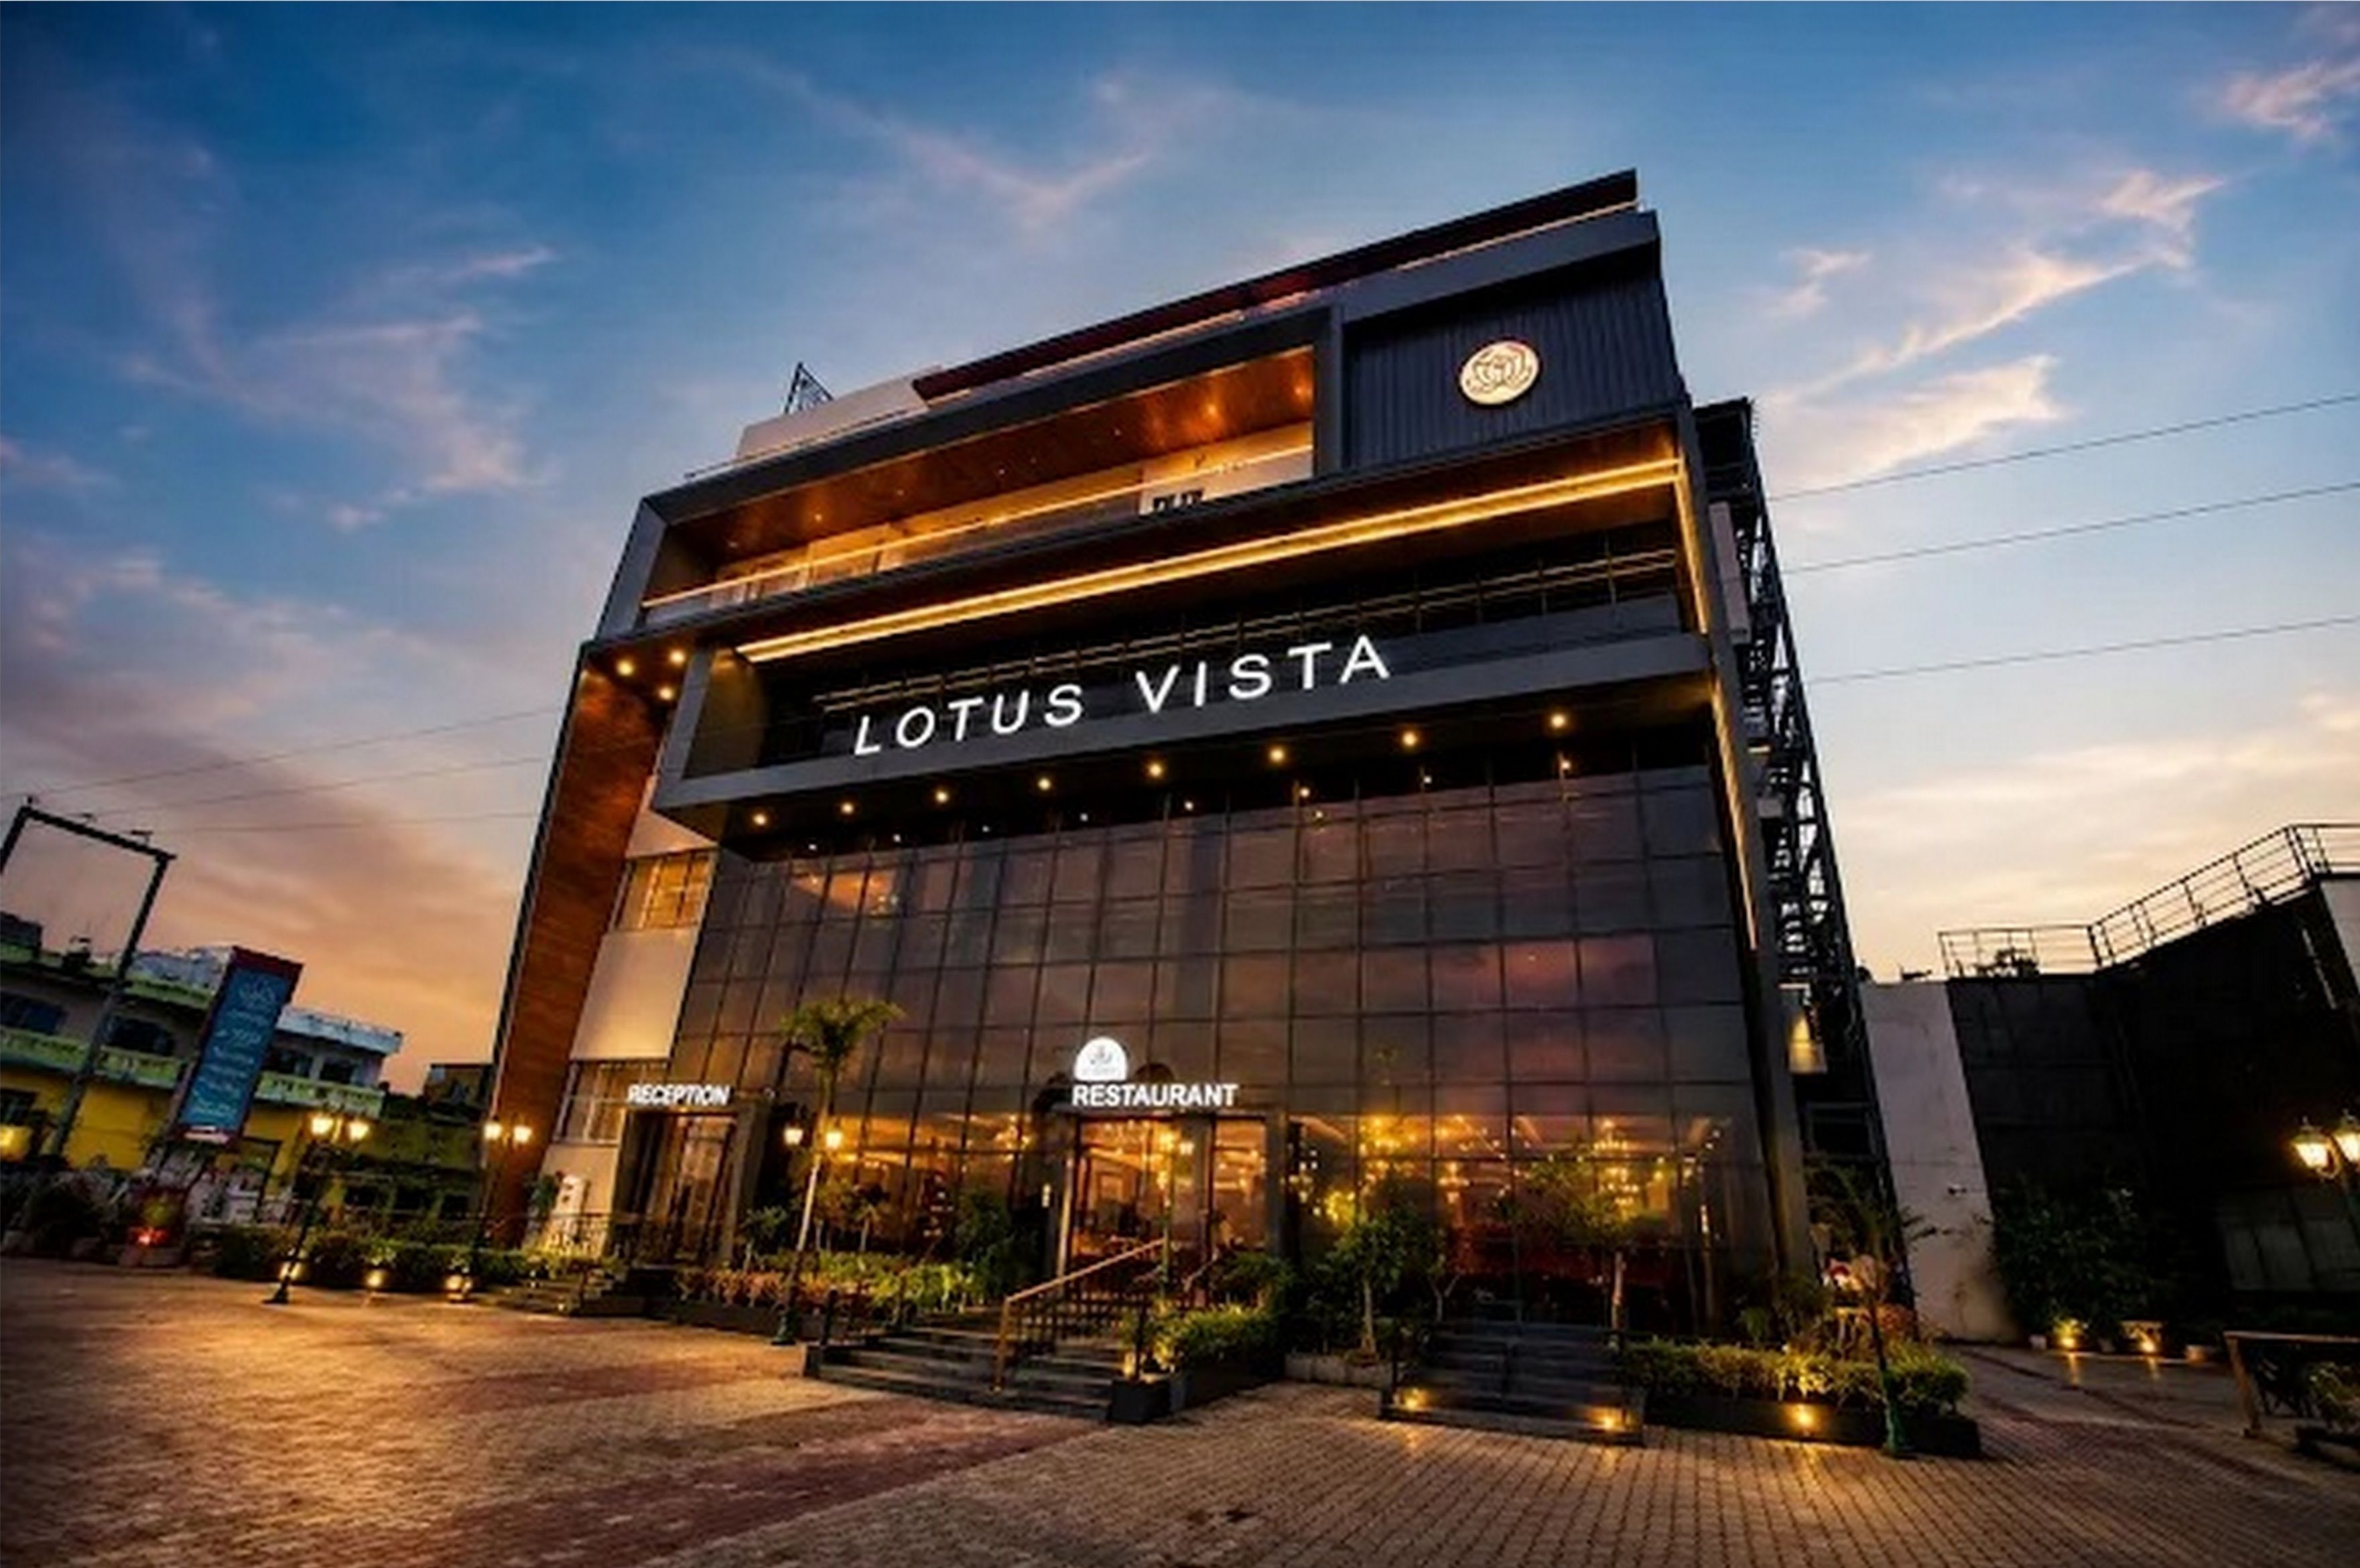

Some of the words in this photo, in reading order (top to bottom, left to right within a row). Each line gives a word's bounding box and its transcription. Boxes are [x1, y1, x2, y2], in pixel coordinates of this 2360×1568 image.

[854, 683, 1084, 756] LOTUS
[1135, 635, 1390, 713] VISTA
[627, 1084, 730, 1106] RECEPTION
[1071, 1084, 1238, 1106] RESTAURANT
